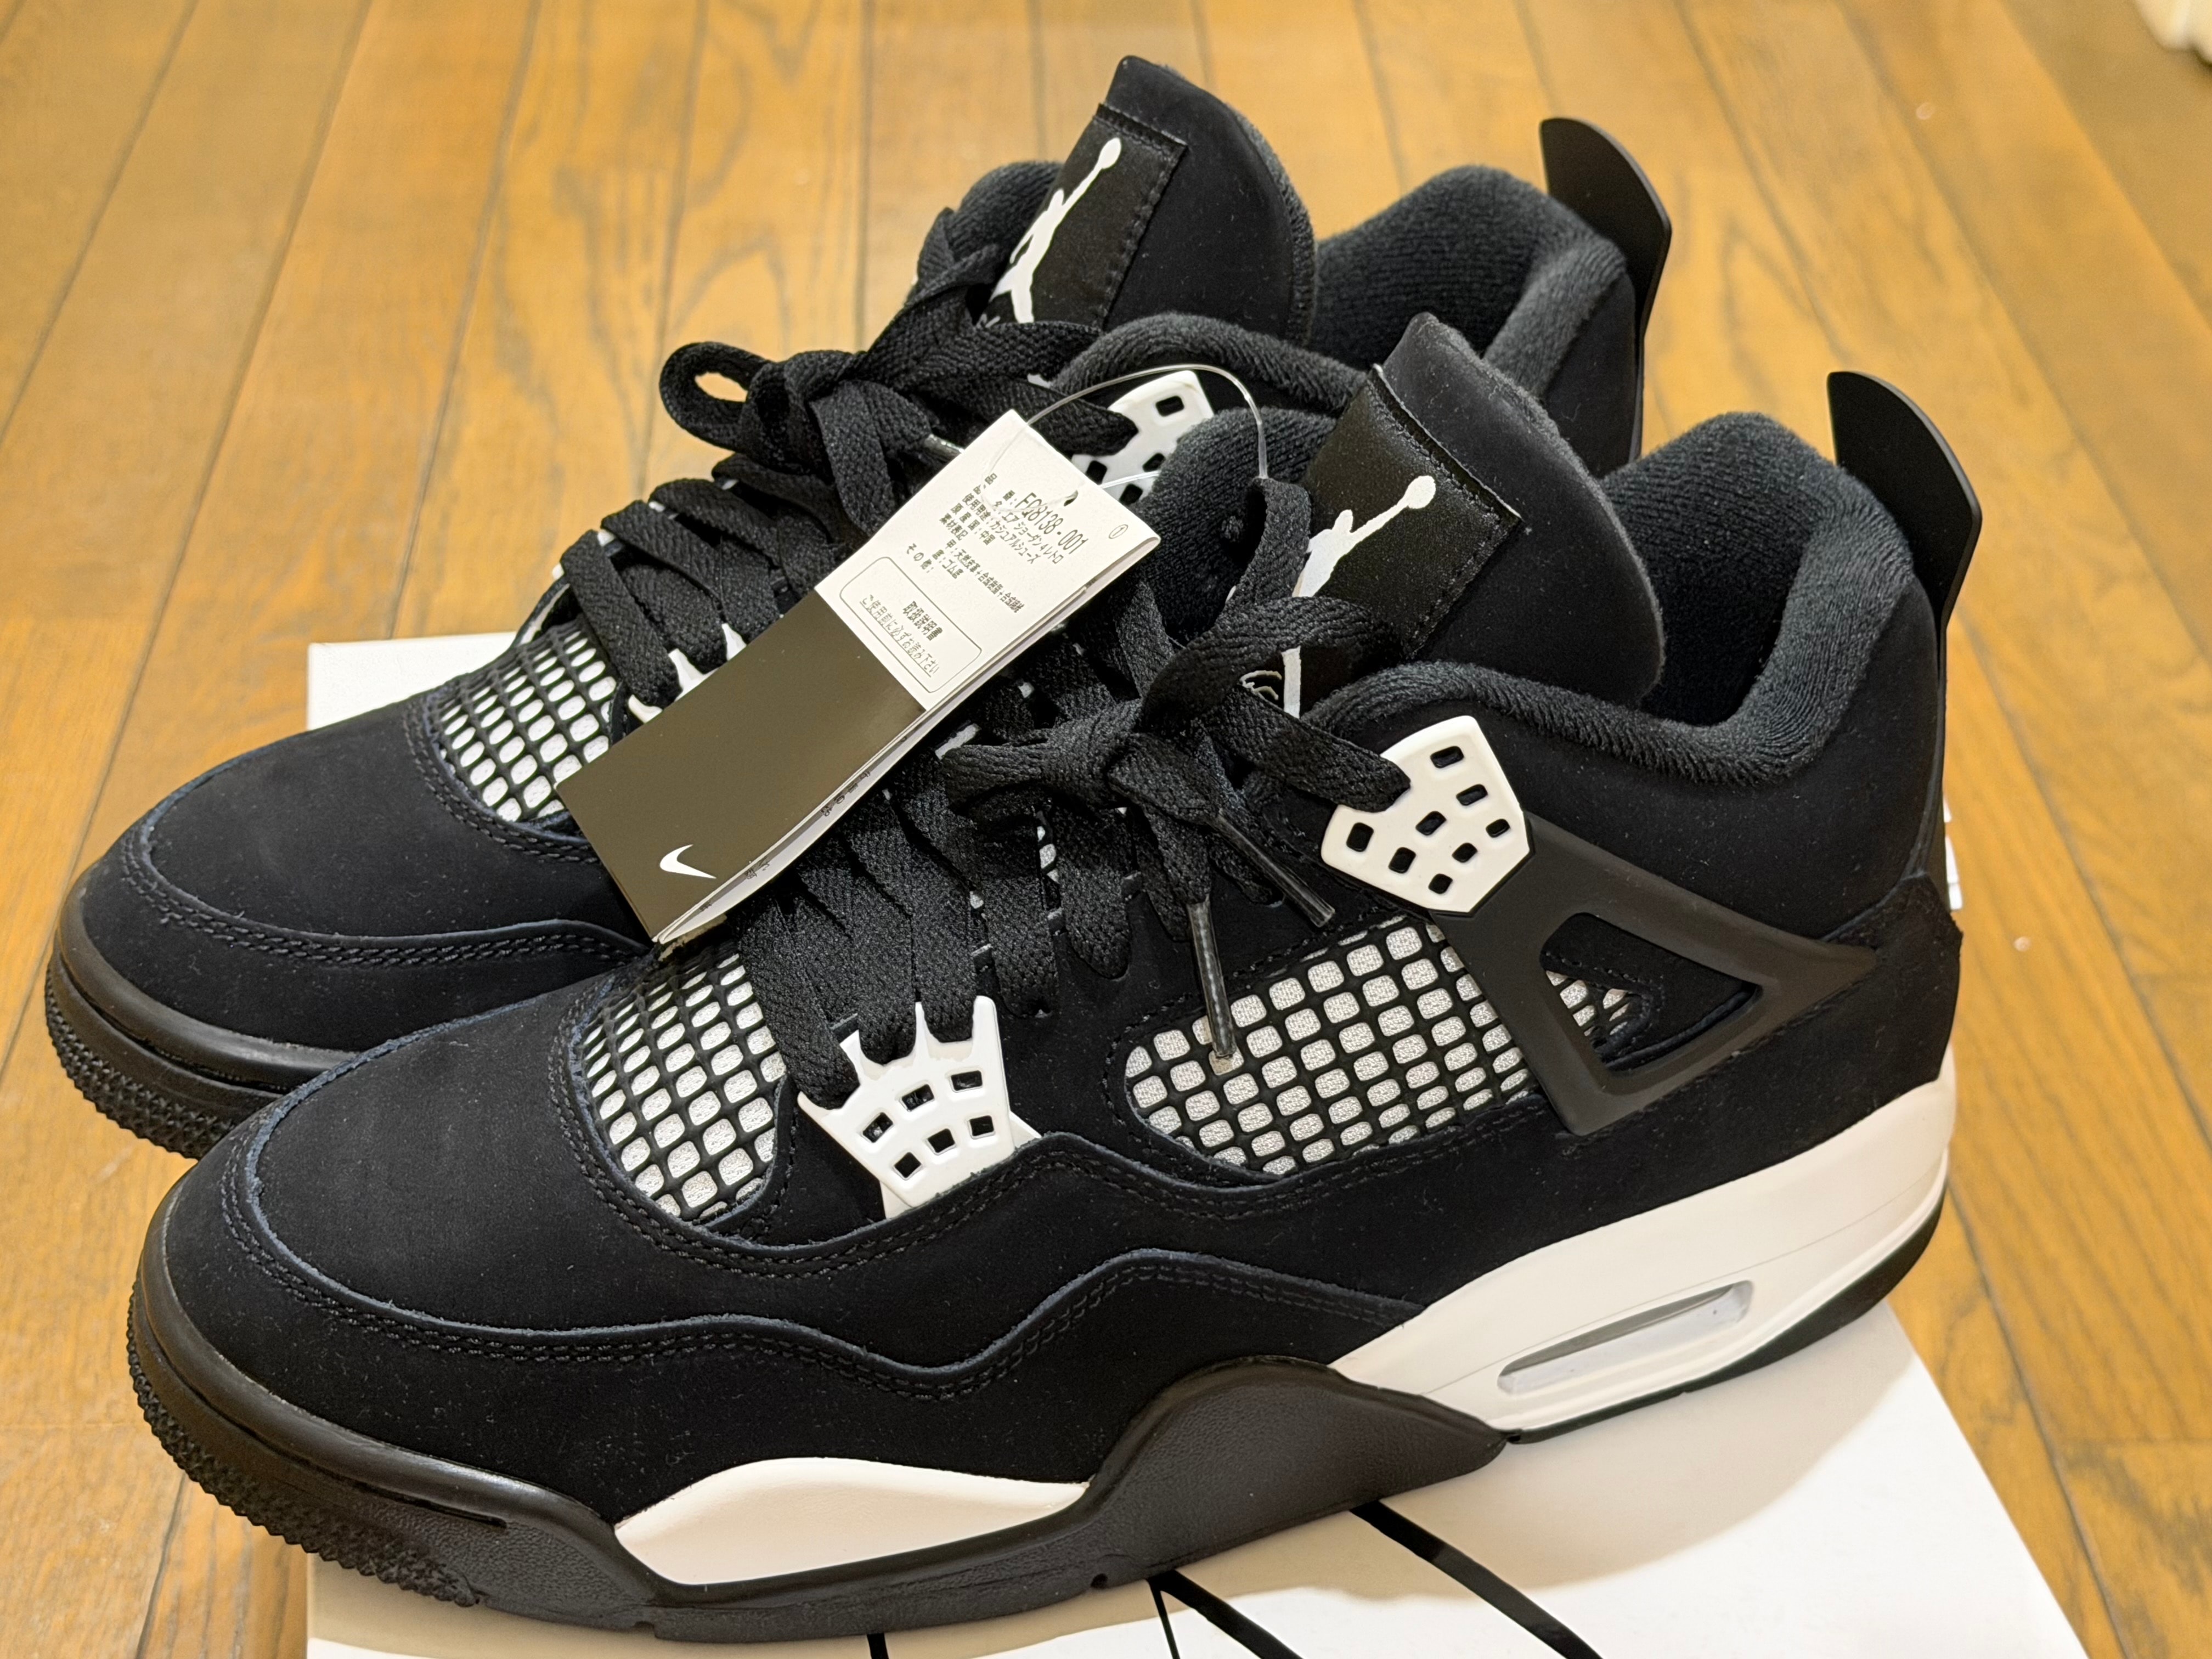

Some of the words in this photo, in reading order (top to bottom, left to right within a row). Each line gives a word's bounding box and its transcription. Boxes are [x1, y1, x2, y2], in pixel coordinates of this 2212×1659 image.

[902, 600, 943, 641] 取扱説明書
